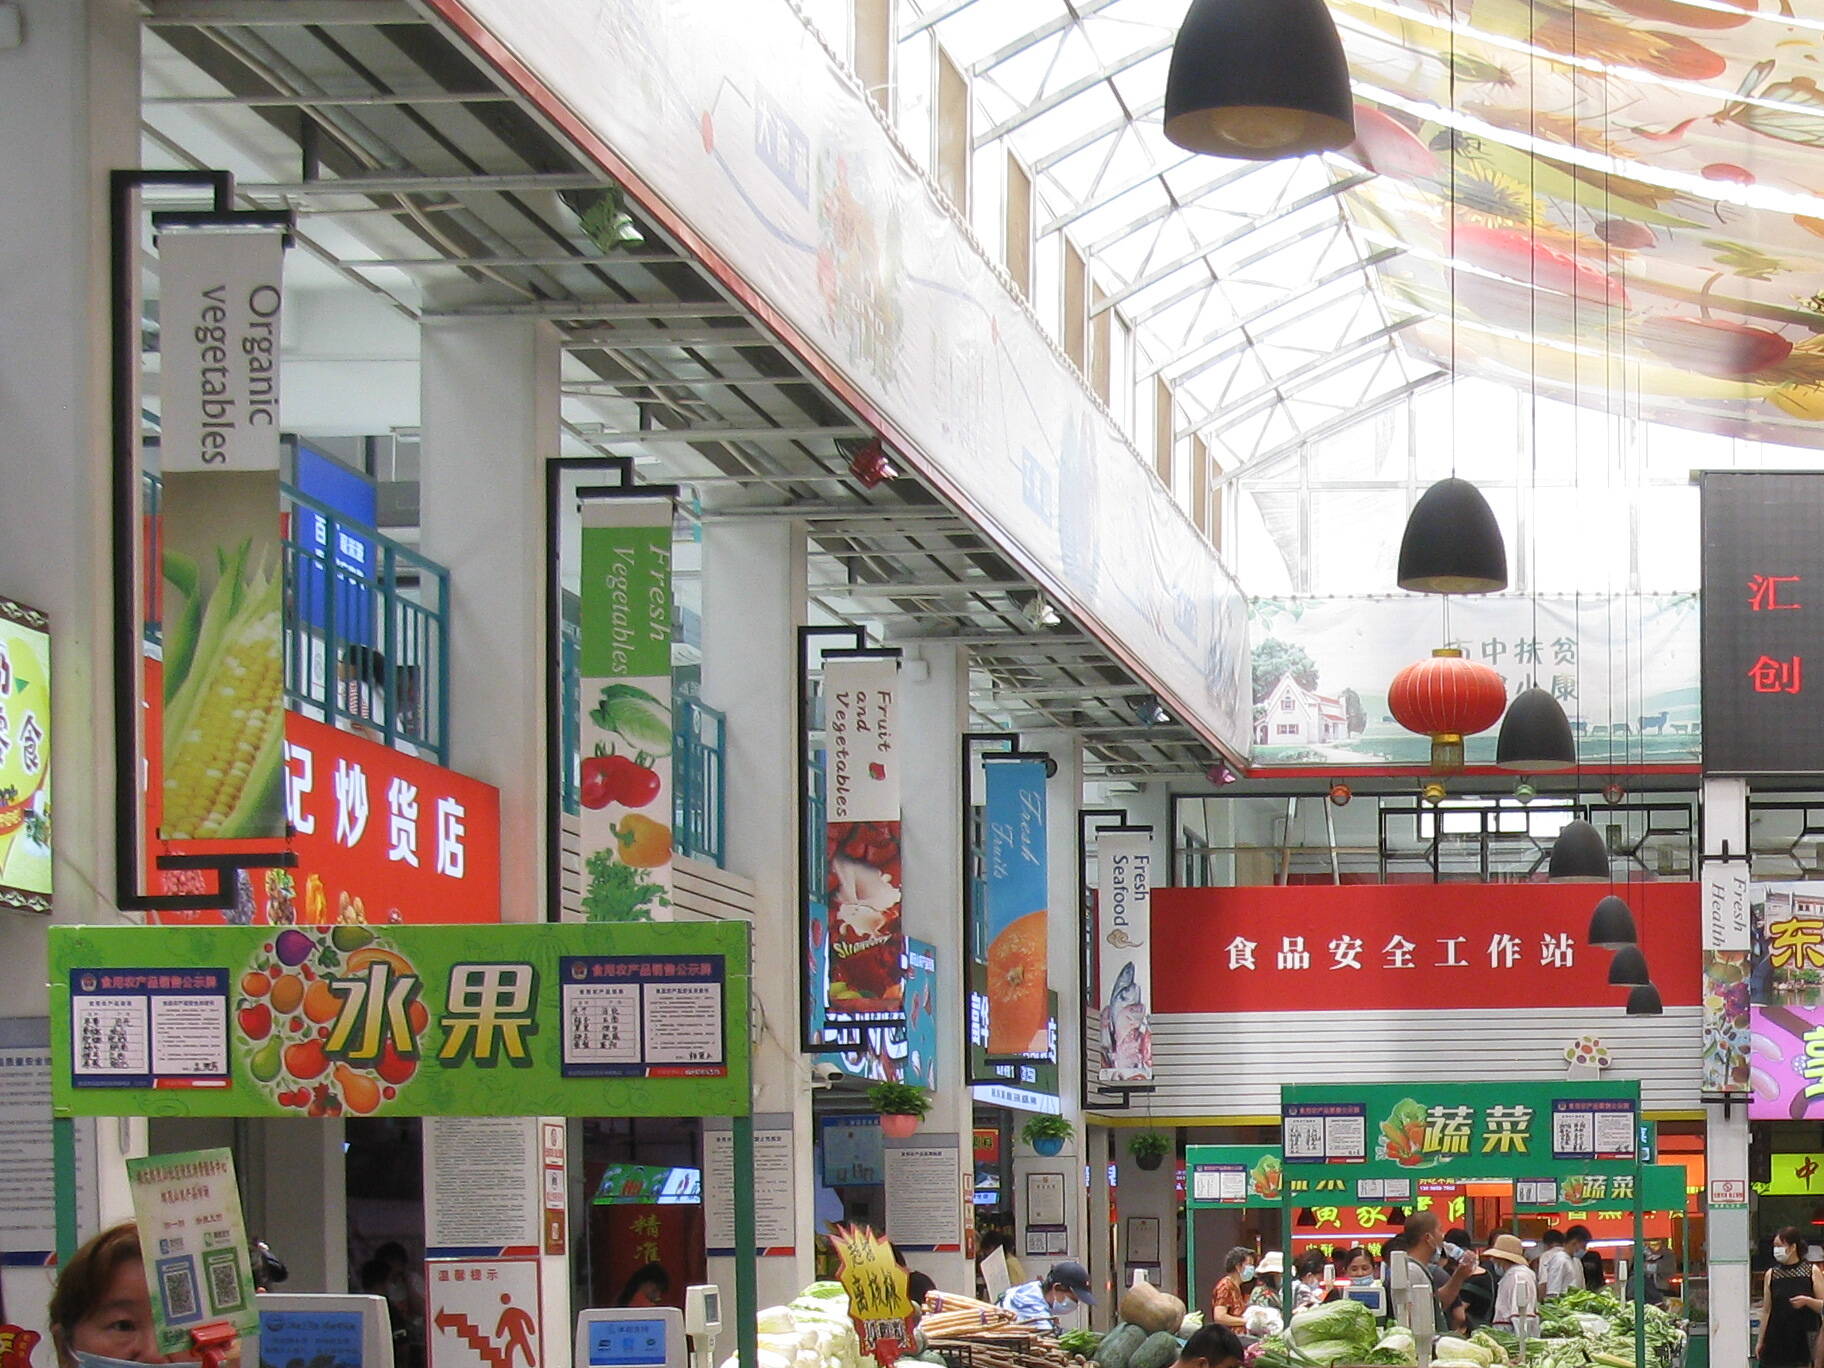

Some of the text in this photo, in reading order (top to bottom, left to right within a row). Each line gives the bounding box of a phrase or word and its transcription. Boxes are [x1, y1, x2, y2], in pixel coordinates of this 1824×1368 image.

[196, 286, 235, 464] vegetables
[243, 285, 282, 425] Organic
[611, 547, 635, 675] Vegetables
[648, 545, 666, 641] Fresh
[856, 691, 870, 732] and
[877, 691, 892, 752] Fruit
[831, 691, 850, 817] Vegetables
[284, 740, 466, 879] 记炒货店
[1020, 789, 1042, 866] Fresh
[1112, 855, 1130, 927] Seafood
[1134, 855, 1150, 901] Fresh
[1733, 876, 1747, 933] Fresh
[1712, 882, 1728, 948] Health
[1225, 933, 1575, 971] 食品安全工作站
[326, 961, 535, 1062] 水果
[1423, 1106, 1533, 1154] 蔬菜
[1582, 1175, 1634, 1199] 蔬菜
[438, 1269, 499, 1281] 温馨提示
